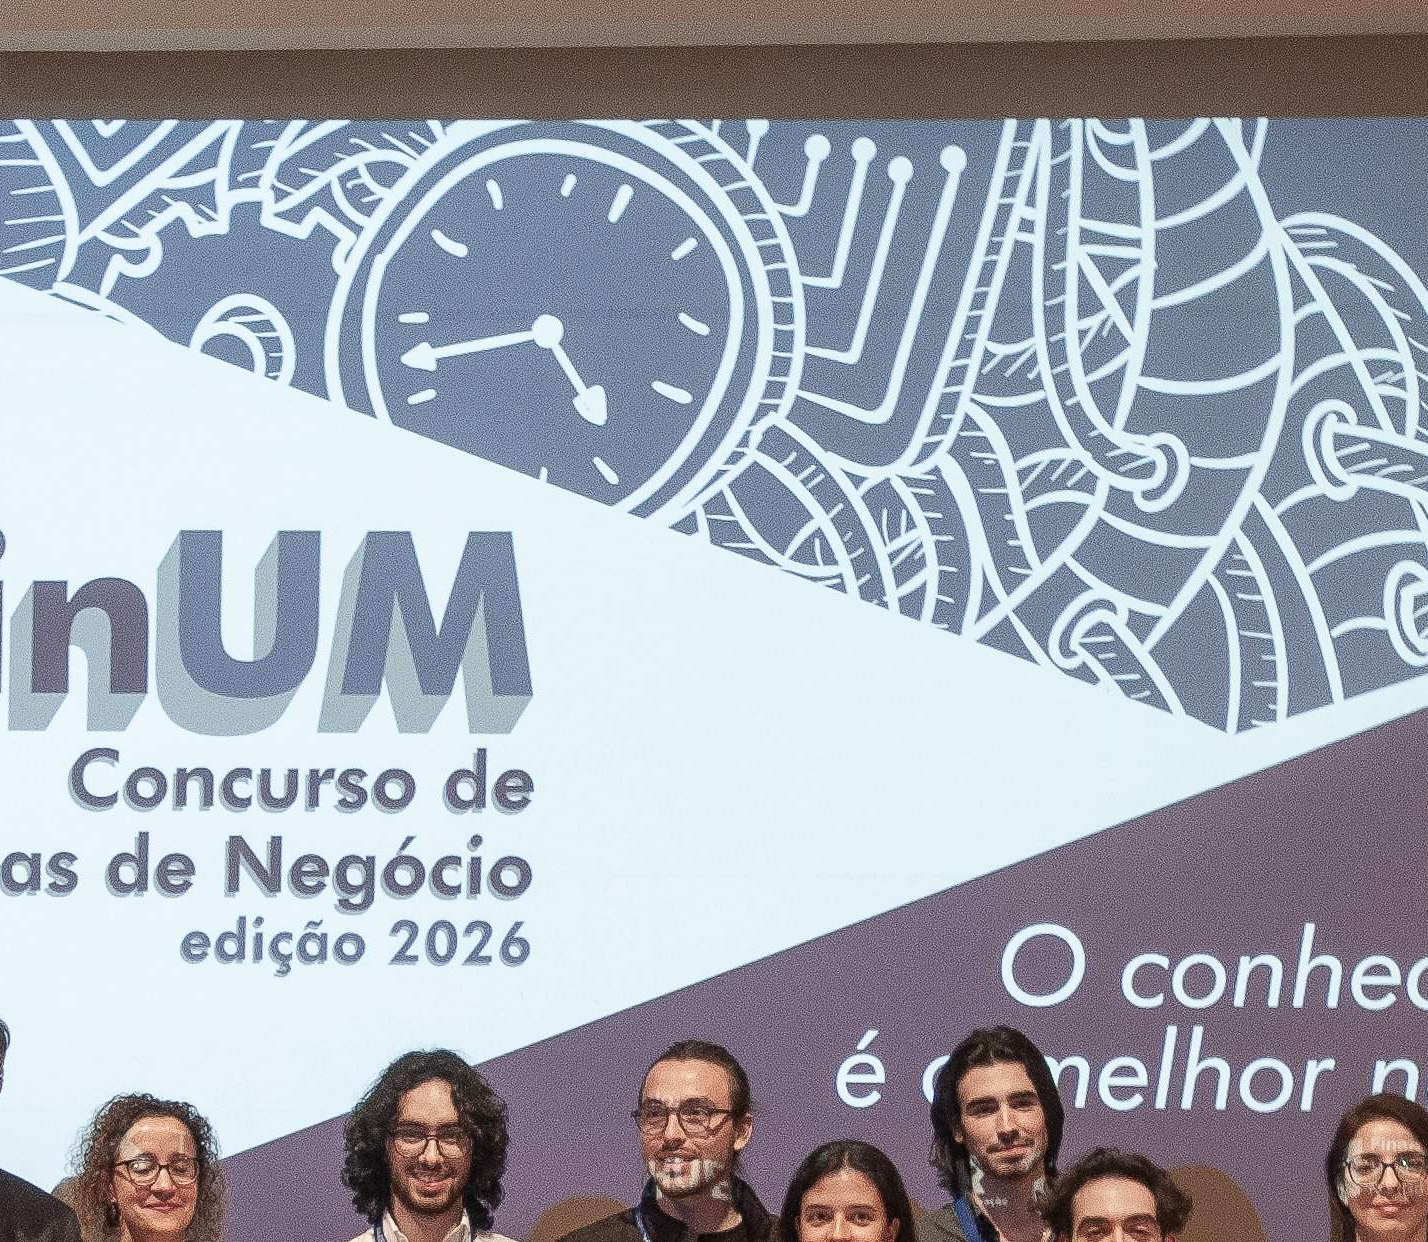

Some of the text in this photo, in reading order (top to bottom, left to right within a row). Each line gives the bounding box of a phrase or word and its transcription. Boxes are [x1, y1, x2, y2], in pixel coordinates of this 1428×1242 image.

[68, 746, 534, 813] Concurso de
[106, 830, 195, 898] de
[223, 833, 533, 914] Negócio
[179, 918, 530, 976] edição 2026
[1001, 923, 1086, 1008] O
[836, 1029, 886, 1108] é
